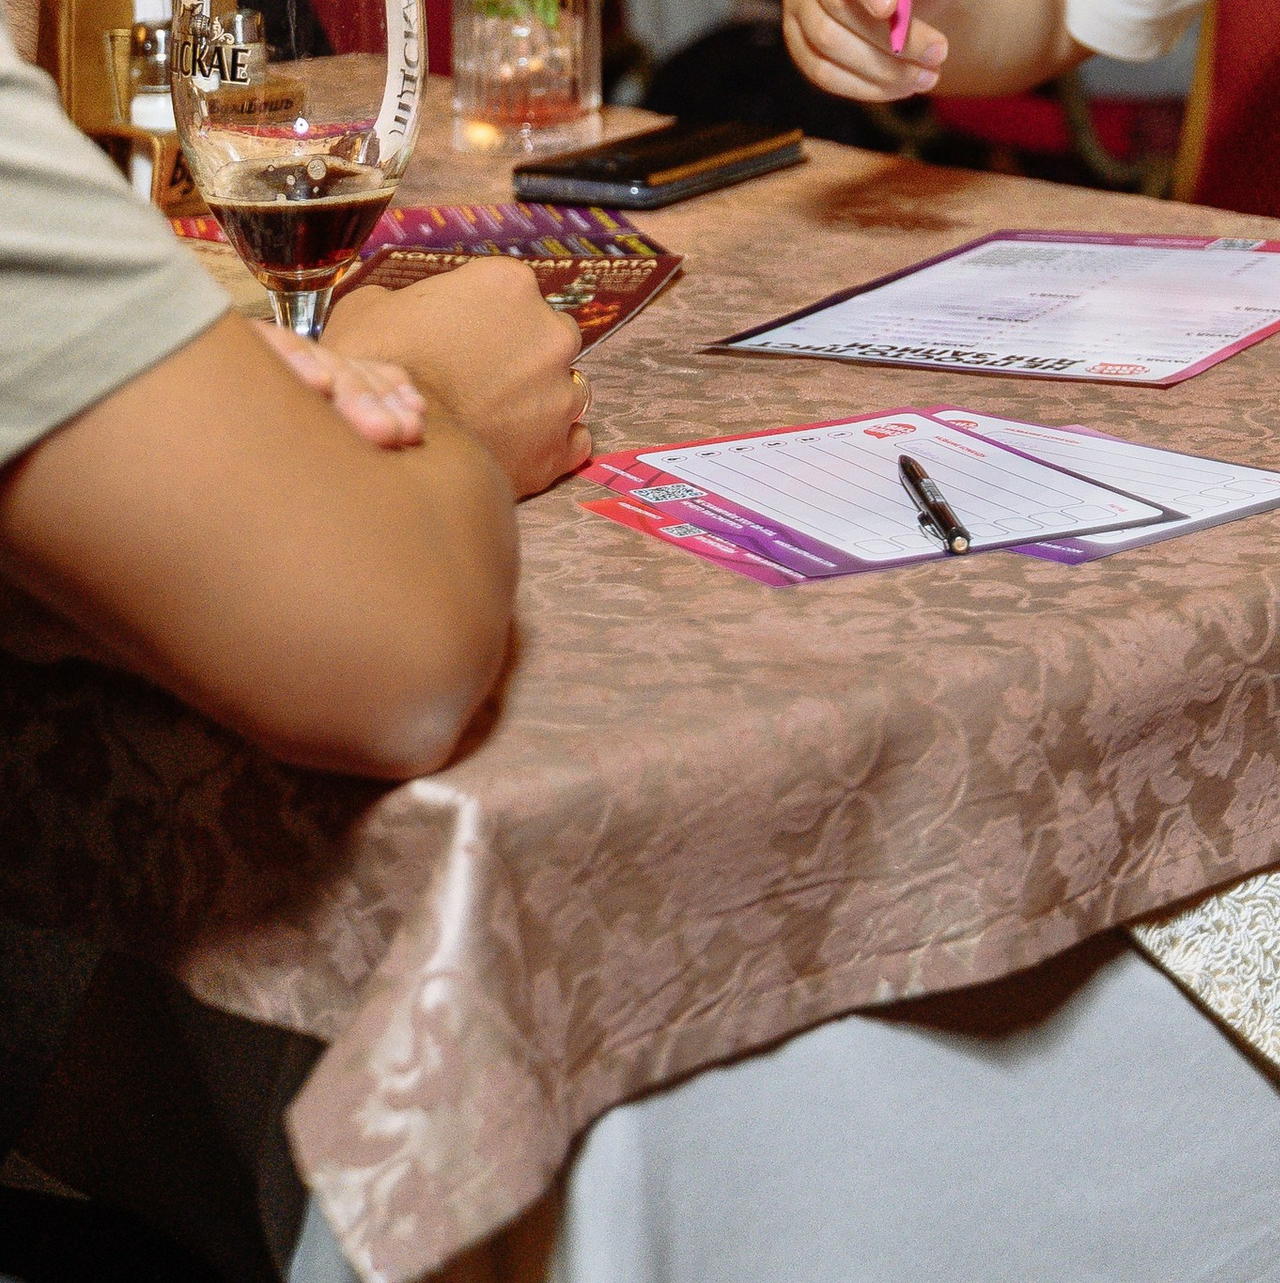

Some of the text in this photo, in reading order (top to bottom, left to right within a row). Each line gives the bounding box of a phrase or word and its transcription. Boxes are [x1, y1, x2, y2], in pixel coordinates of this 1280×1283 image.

[578, 257, 658, 269] КАРТА
[753, 340, 1072, 371] НЕ ПРОСТО ЛИСТ
[1001, 354, 1086, 367] ДЛЯ
